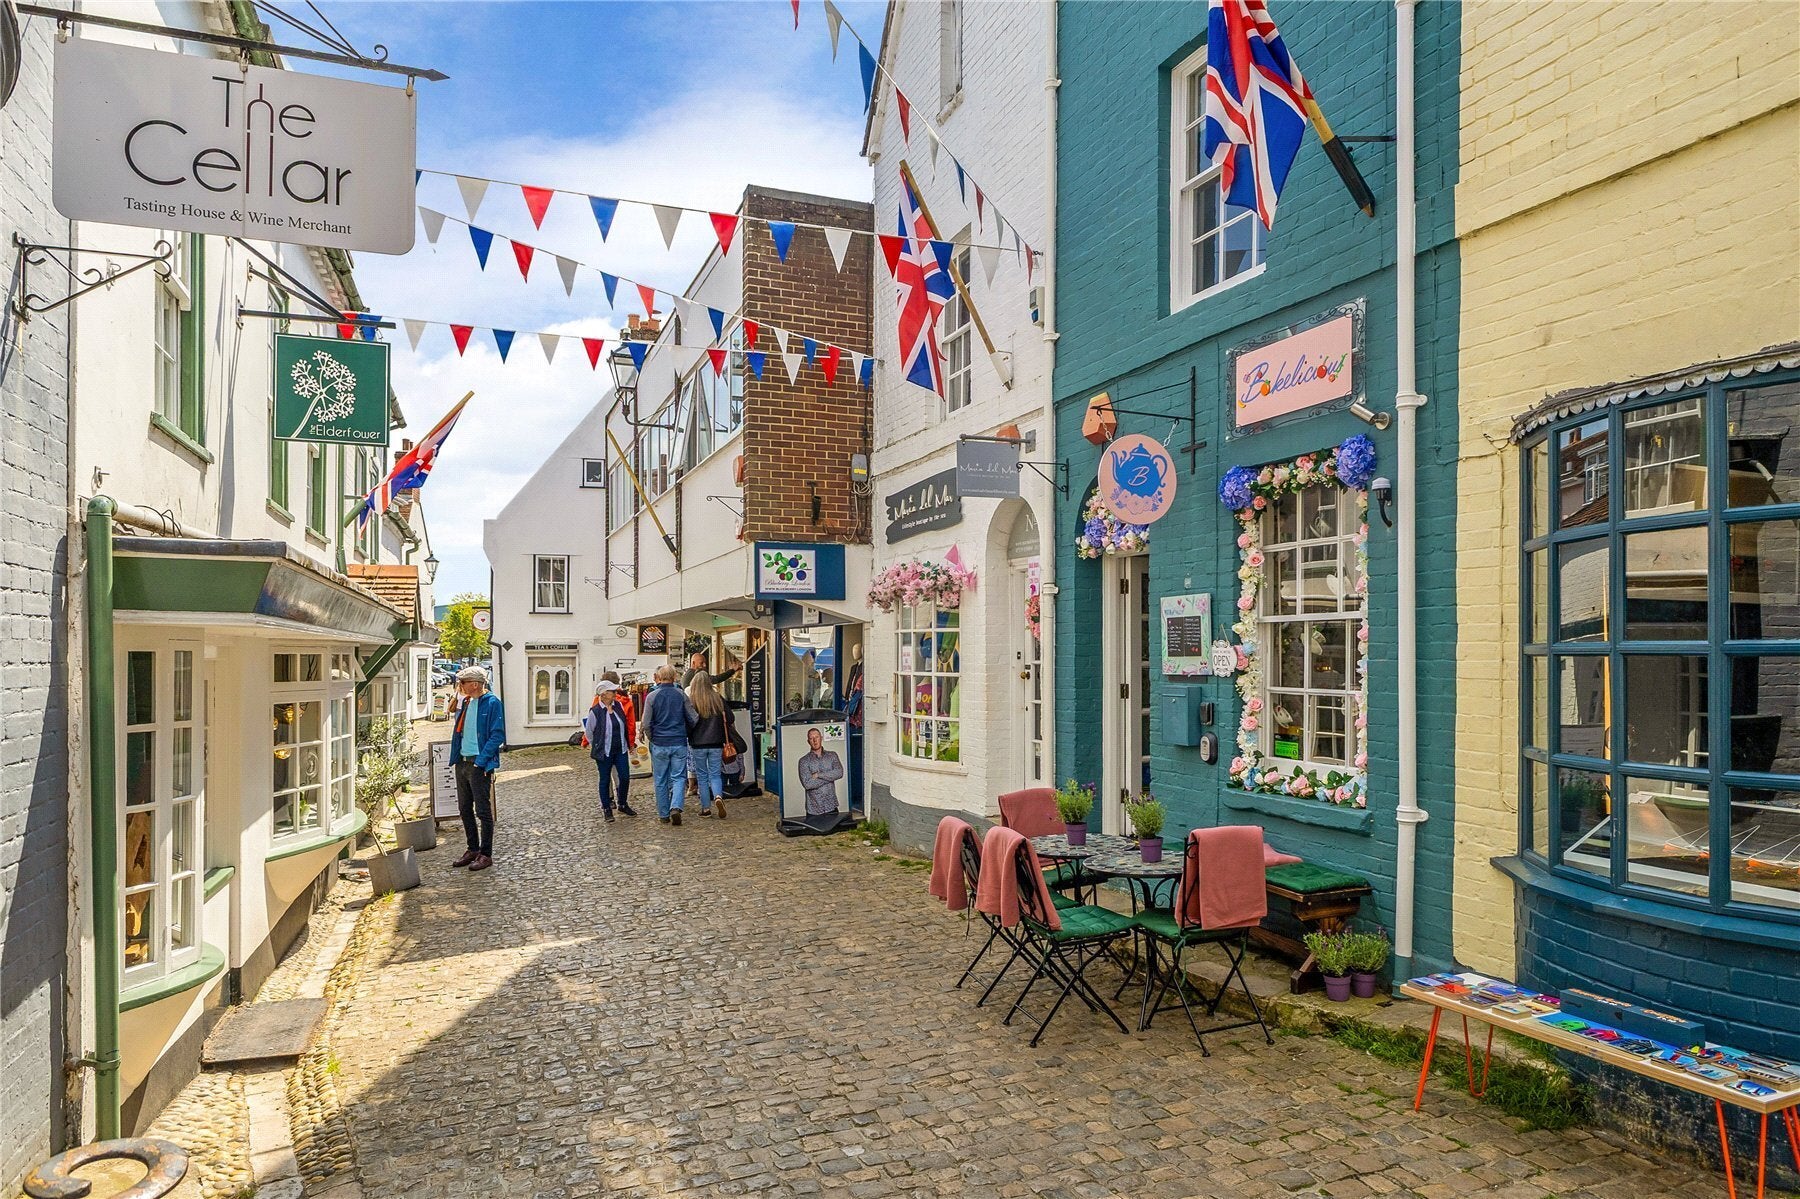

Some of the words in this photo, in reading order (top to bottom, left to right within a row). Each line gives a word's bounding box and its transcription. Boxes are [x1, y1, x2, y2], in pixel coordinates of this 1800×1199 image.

[212, 76, 316, 138] The
[124, 119, 352, 206] Cellar
[123, 197, 177, 217] Tasting
[181, 204, 226, 221] House
[230, 210, 243, 222] &
[248, 211, 284, 227] Wine
[287, 217, 352, 235] Merchant
[1127, 465, 1150, 487] B
[893, 494, 917, 521] Maria
[935, 484, 954, 508] Mar
[1213, 655, 1231, 667] OPEN
